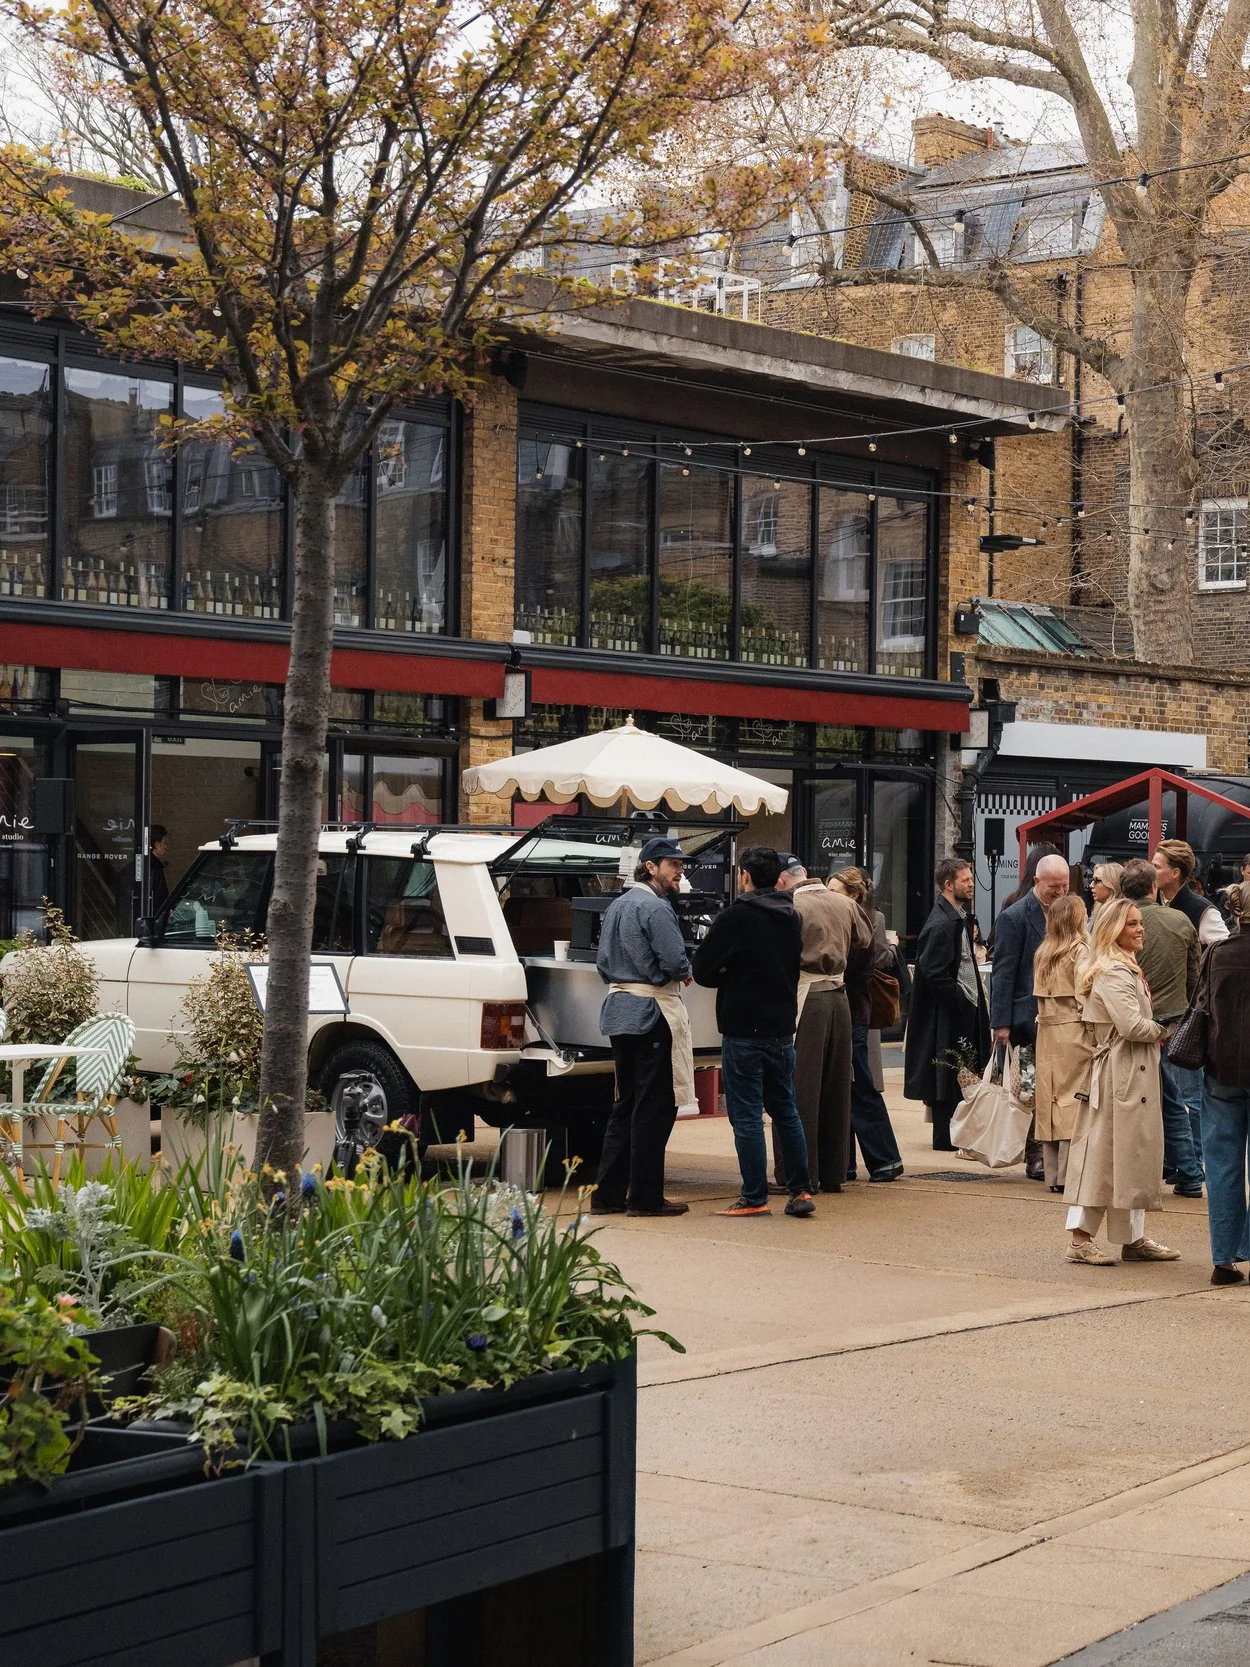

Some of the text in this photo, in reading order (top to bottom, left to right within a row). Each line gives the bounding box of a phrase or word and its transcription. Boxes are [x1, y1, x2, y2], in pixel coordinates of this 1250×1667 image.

[229, 684, 263, 713] amie
[1, 832, 24, 841] studio
[821, 837, 857, 849] amie
